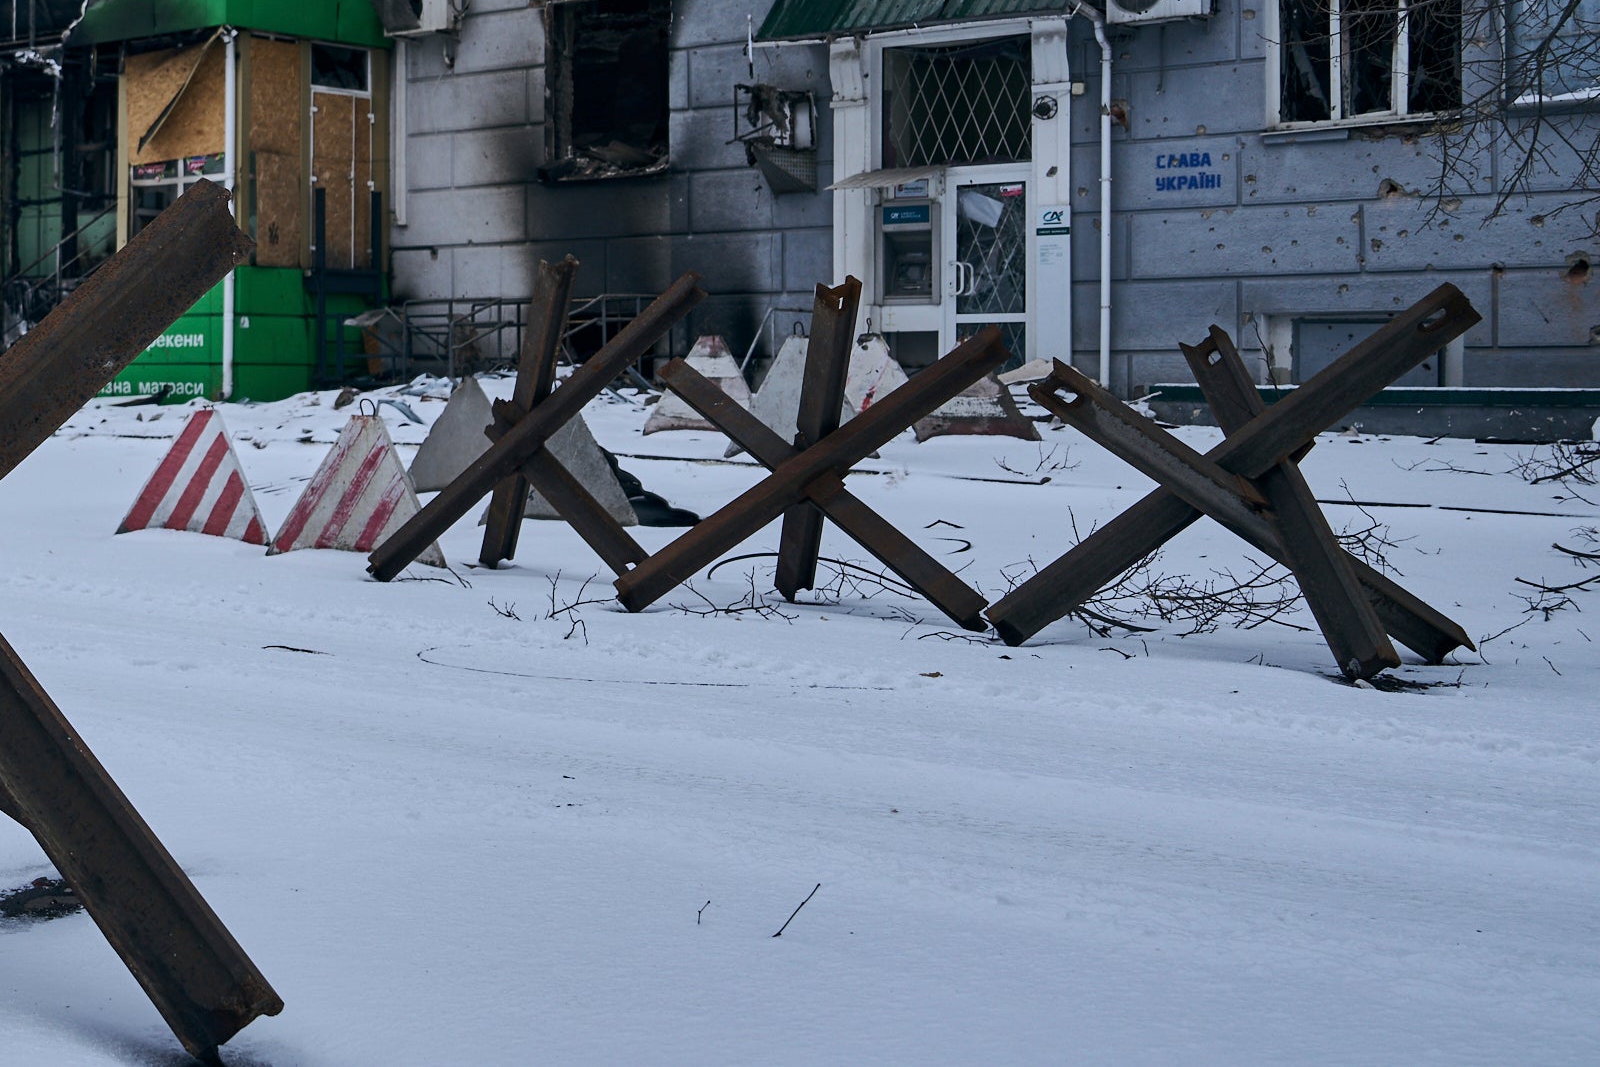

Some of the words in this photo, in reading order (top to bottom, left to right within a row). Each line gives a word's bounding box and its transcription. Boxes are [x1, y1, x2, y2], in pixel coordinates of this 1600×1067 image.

[1156, 152, 1211, 169] СЛАВА
[1156, 172, 1221, 191] УКРАЇНІ
[138, 382, 204, 398] матраси
